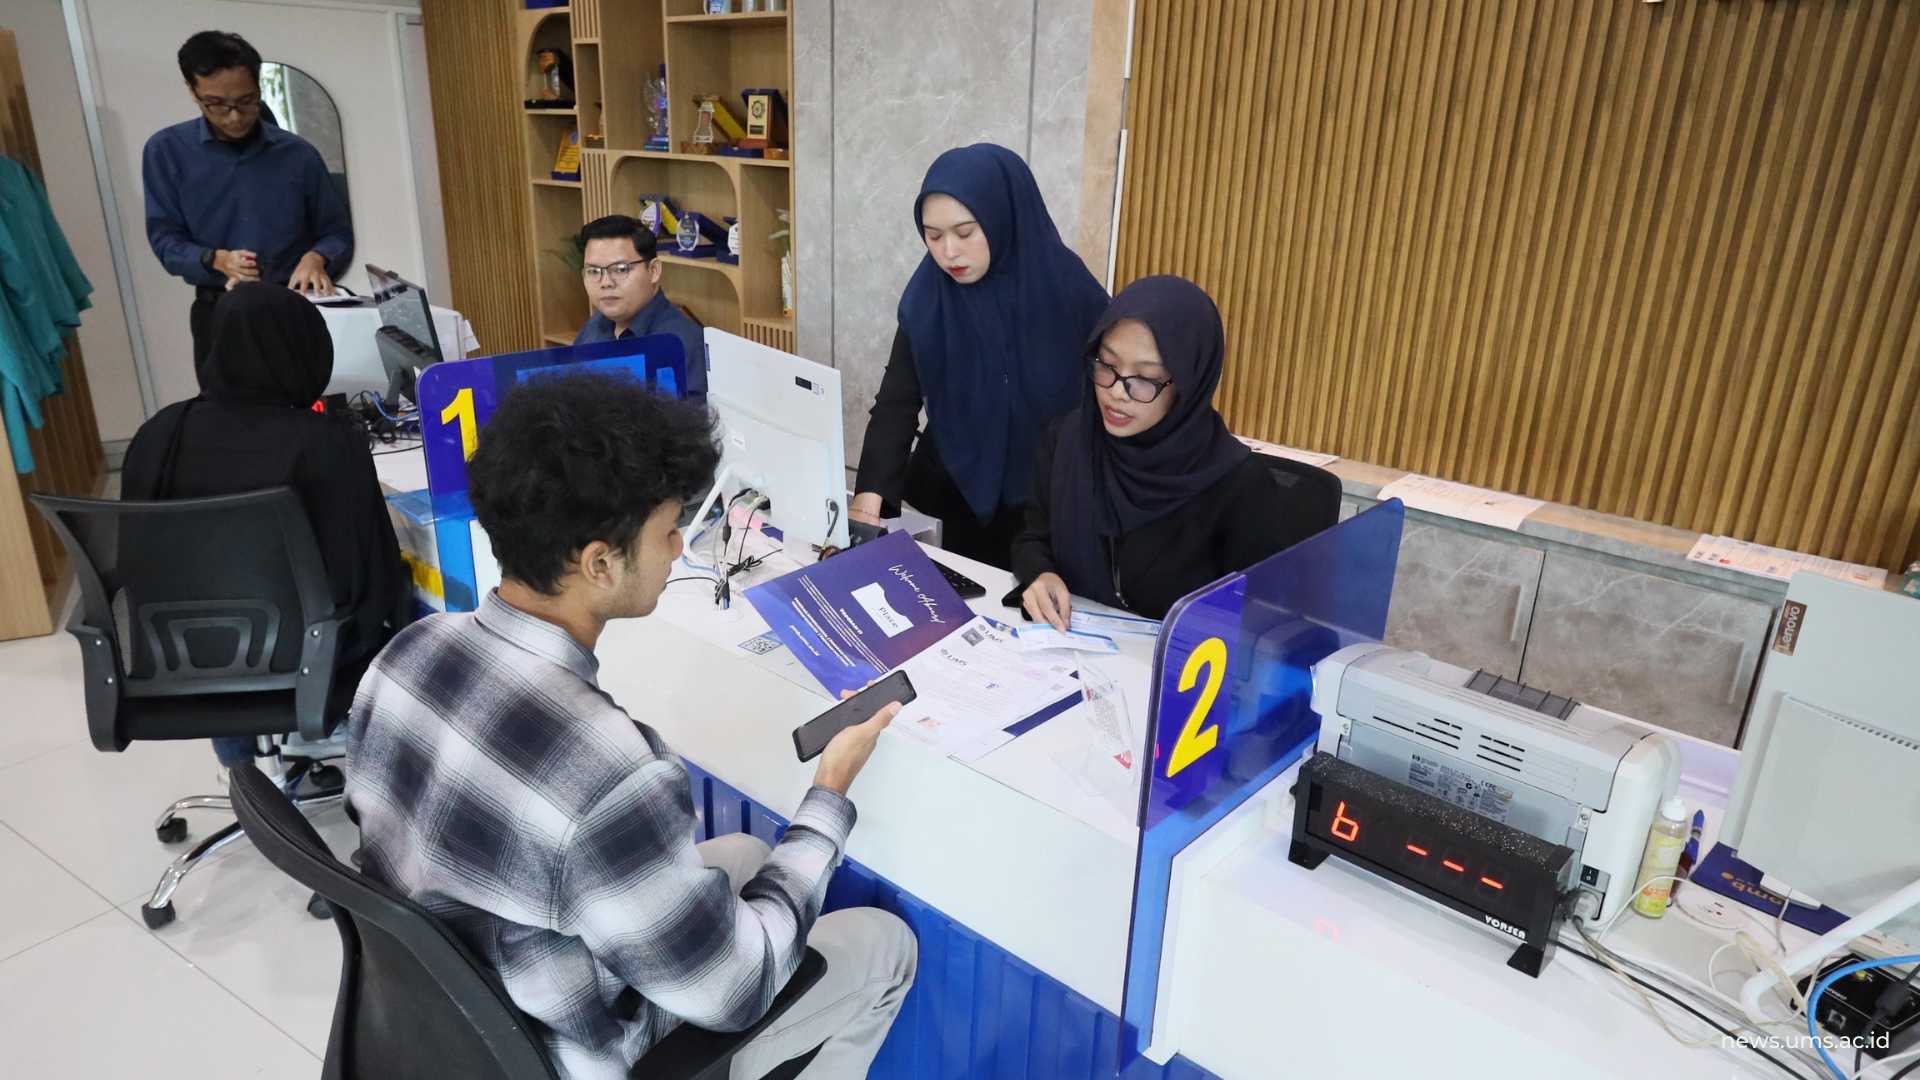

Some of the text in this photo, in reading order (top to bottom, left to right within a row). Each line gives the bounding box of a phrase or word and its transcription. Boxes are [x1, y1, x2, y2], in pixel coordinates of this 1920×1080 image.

[441, 387, 479, 462] 1
[1778, 605, 1801, 650] Lenovo
[1166, 636, 1228, 778] 2
